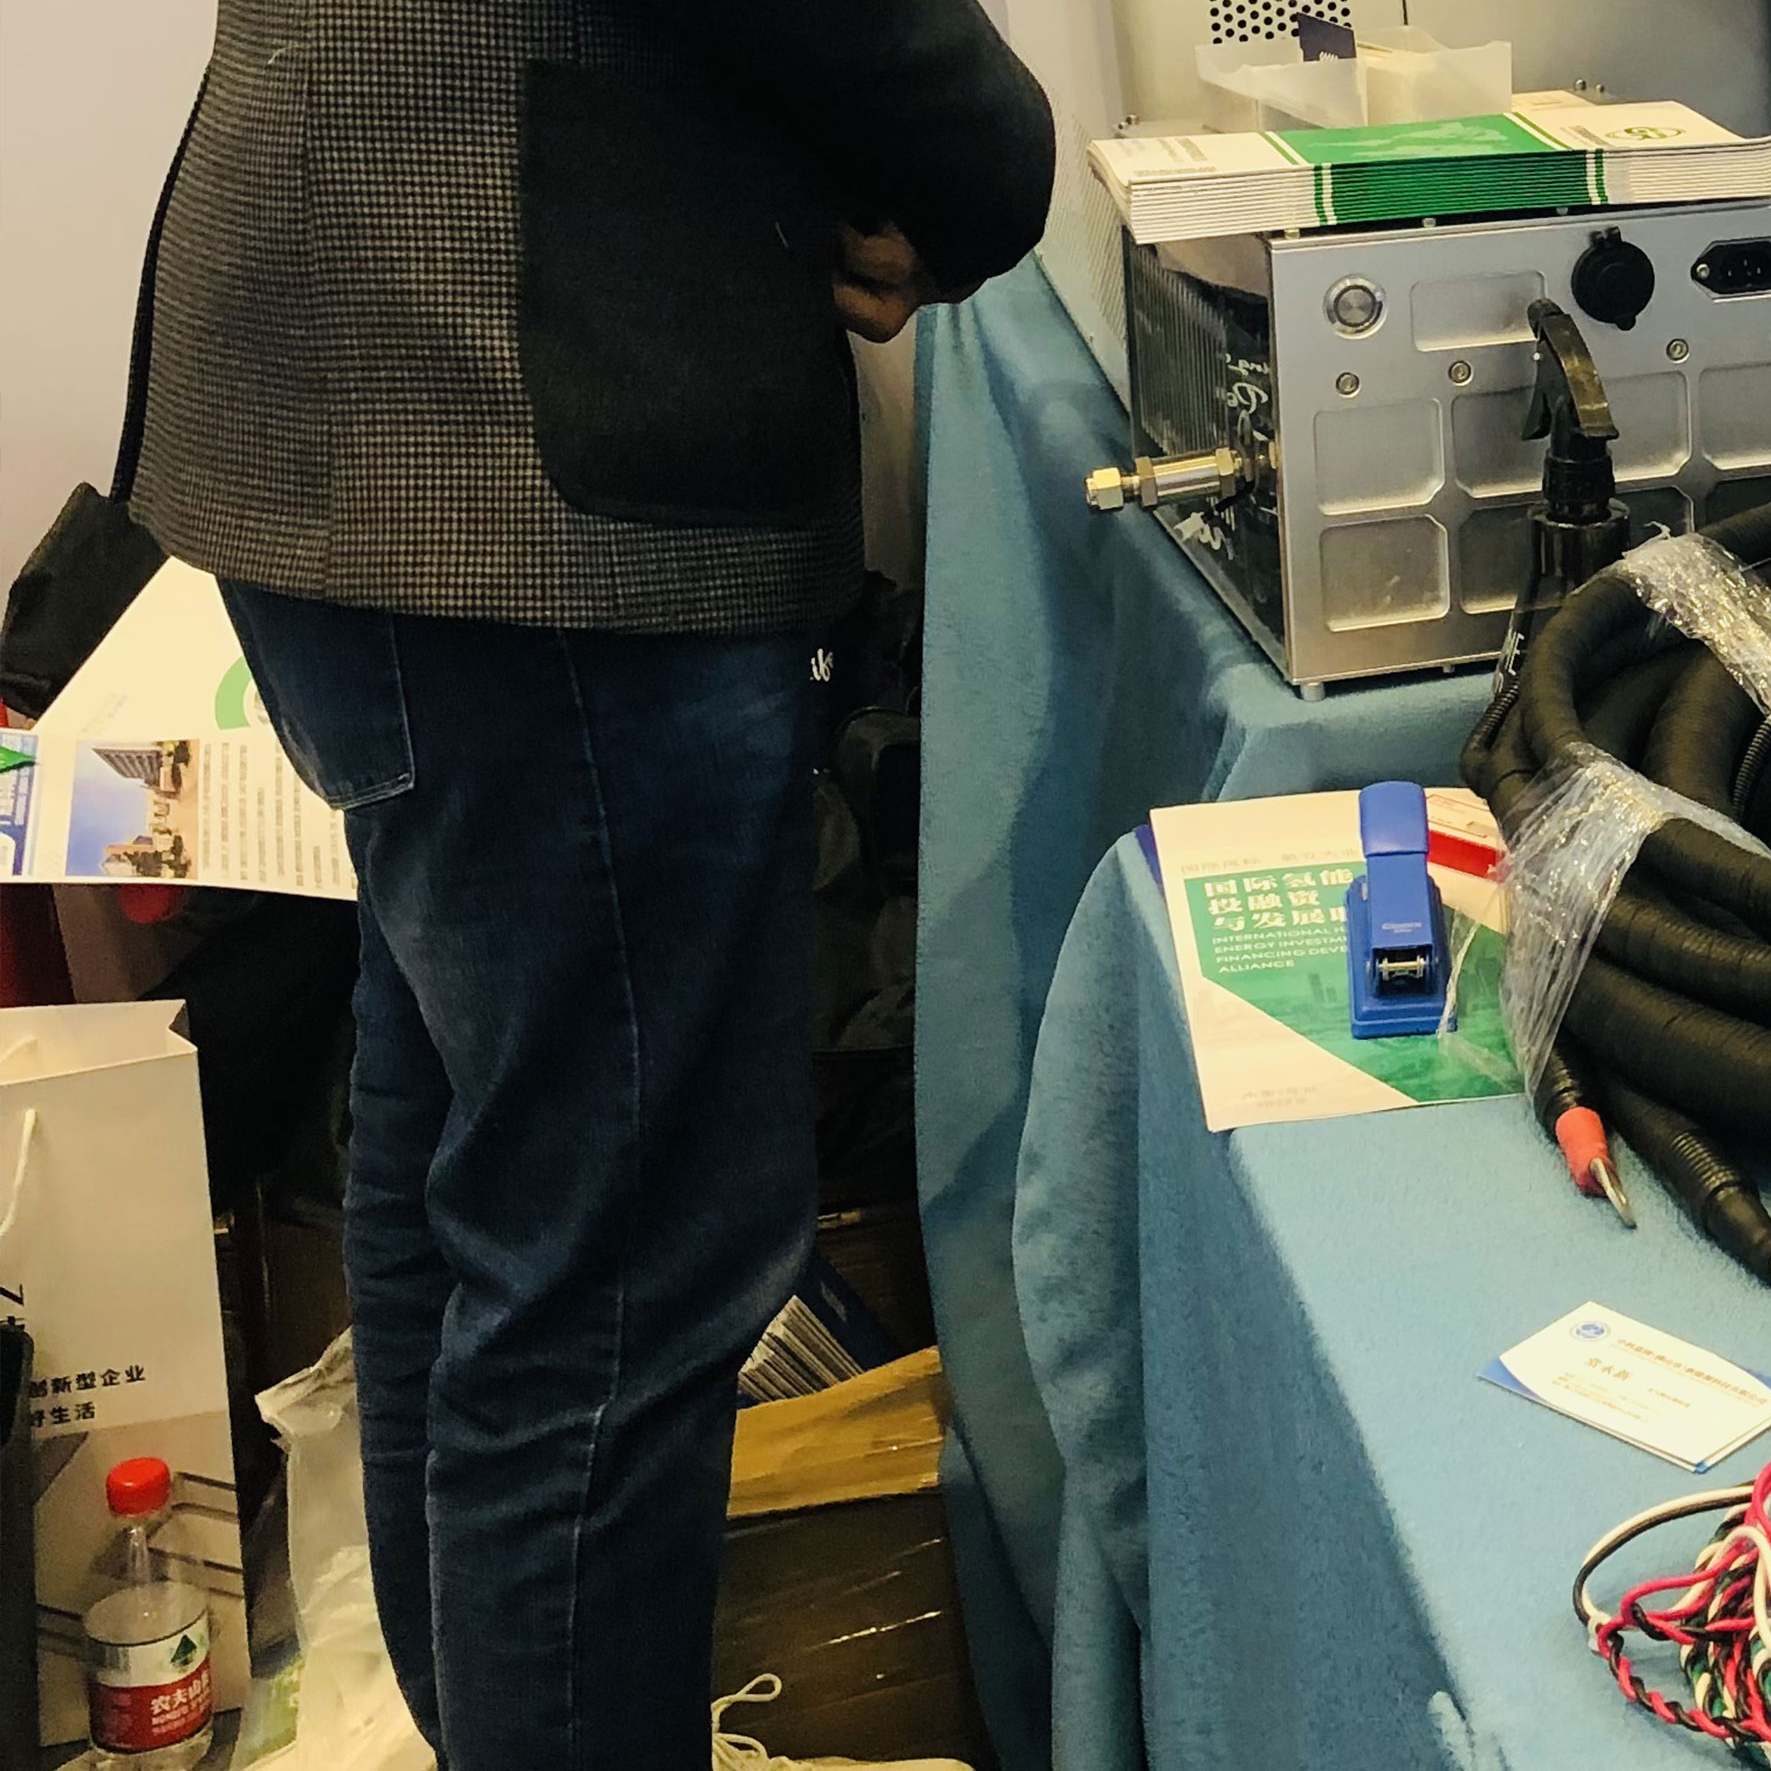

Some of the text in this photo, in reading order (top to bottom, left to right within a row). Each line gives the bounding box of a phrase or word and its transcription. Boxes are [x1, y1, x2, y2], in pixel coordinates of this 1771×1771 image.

[1204, 868, 1354, 897] 国际氢能
[1208, 890, 1320, 915] 投融资
[1212, 928, 1329, 945] INTERNATIONAL
[1215, 941, 1275, 954] ENERGY
[1216, 949, 1306, 963] FINANCING
[1219, 960, 1295, 973] ALLIANCE
